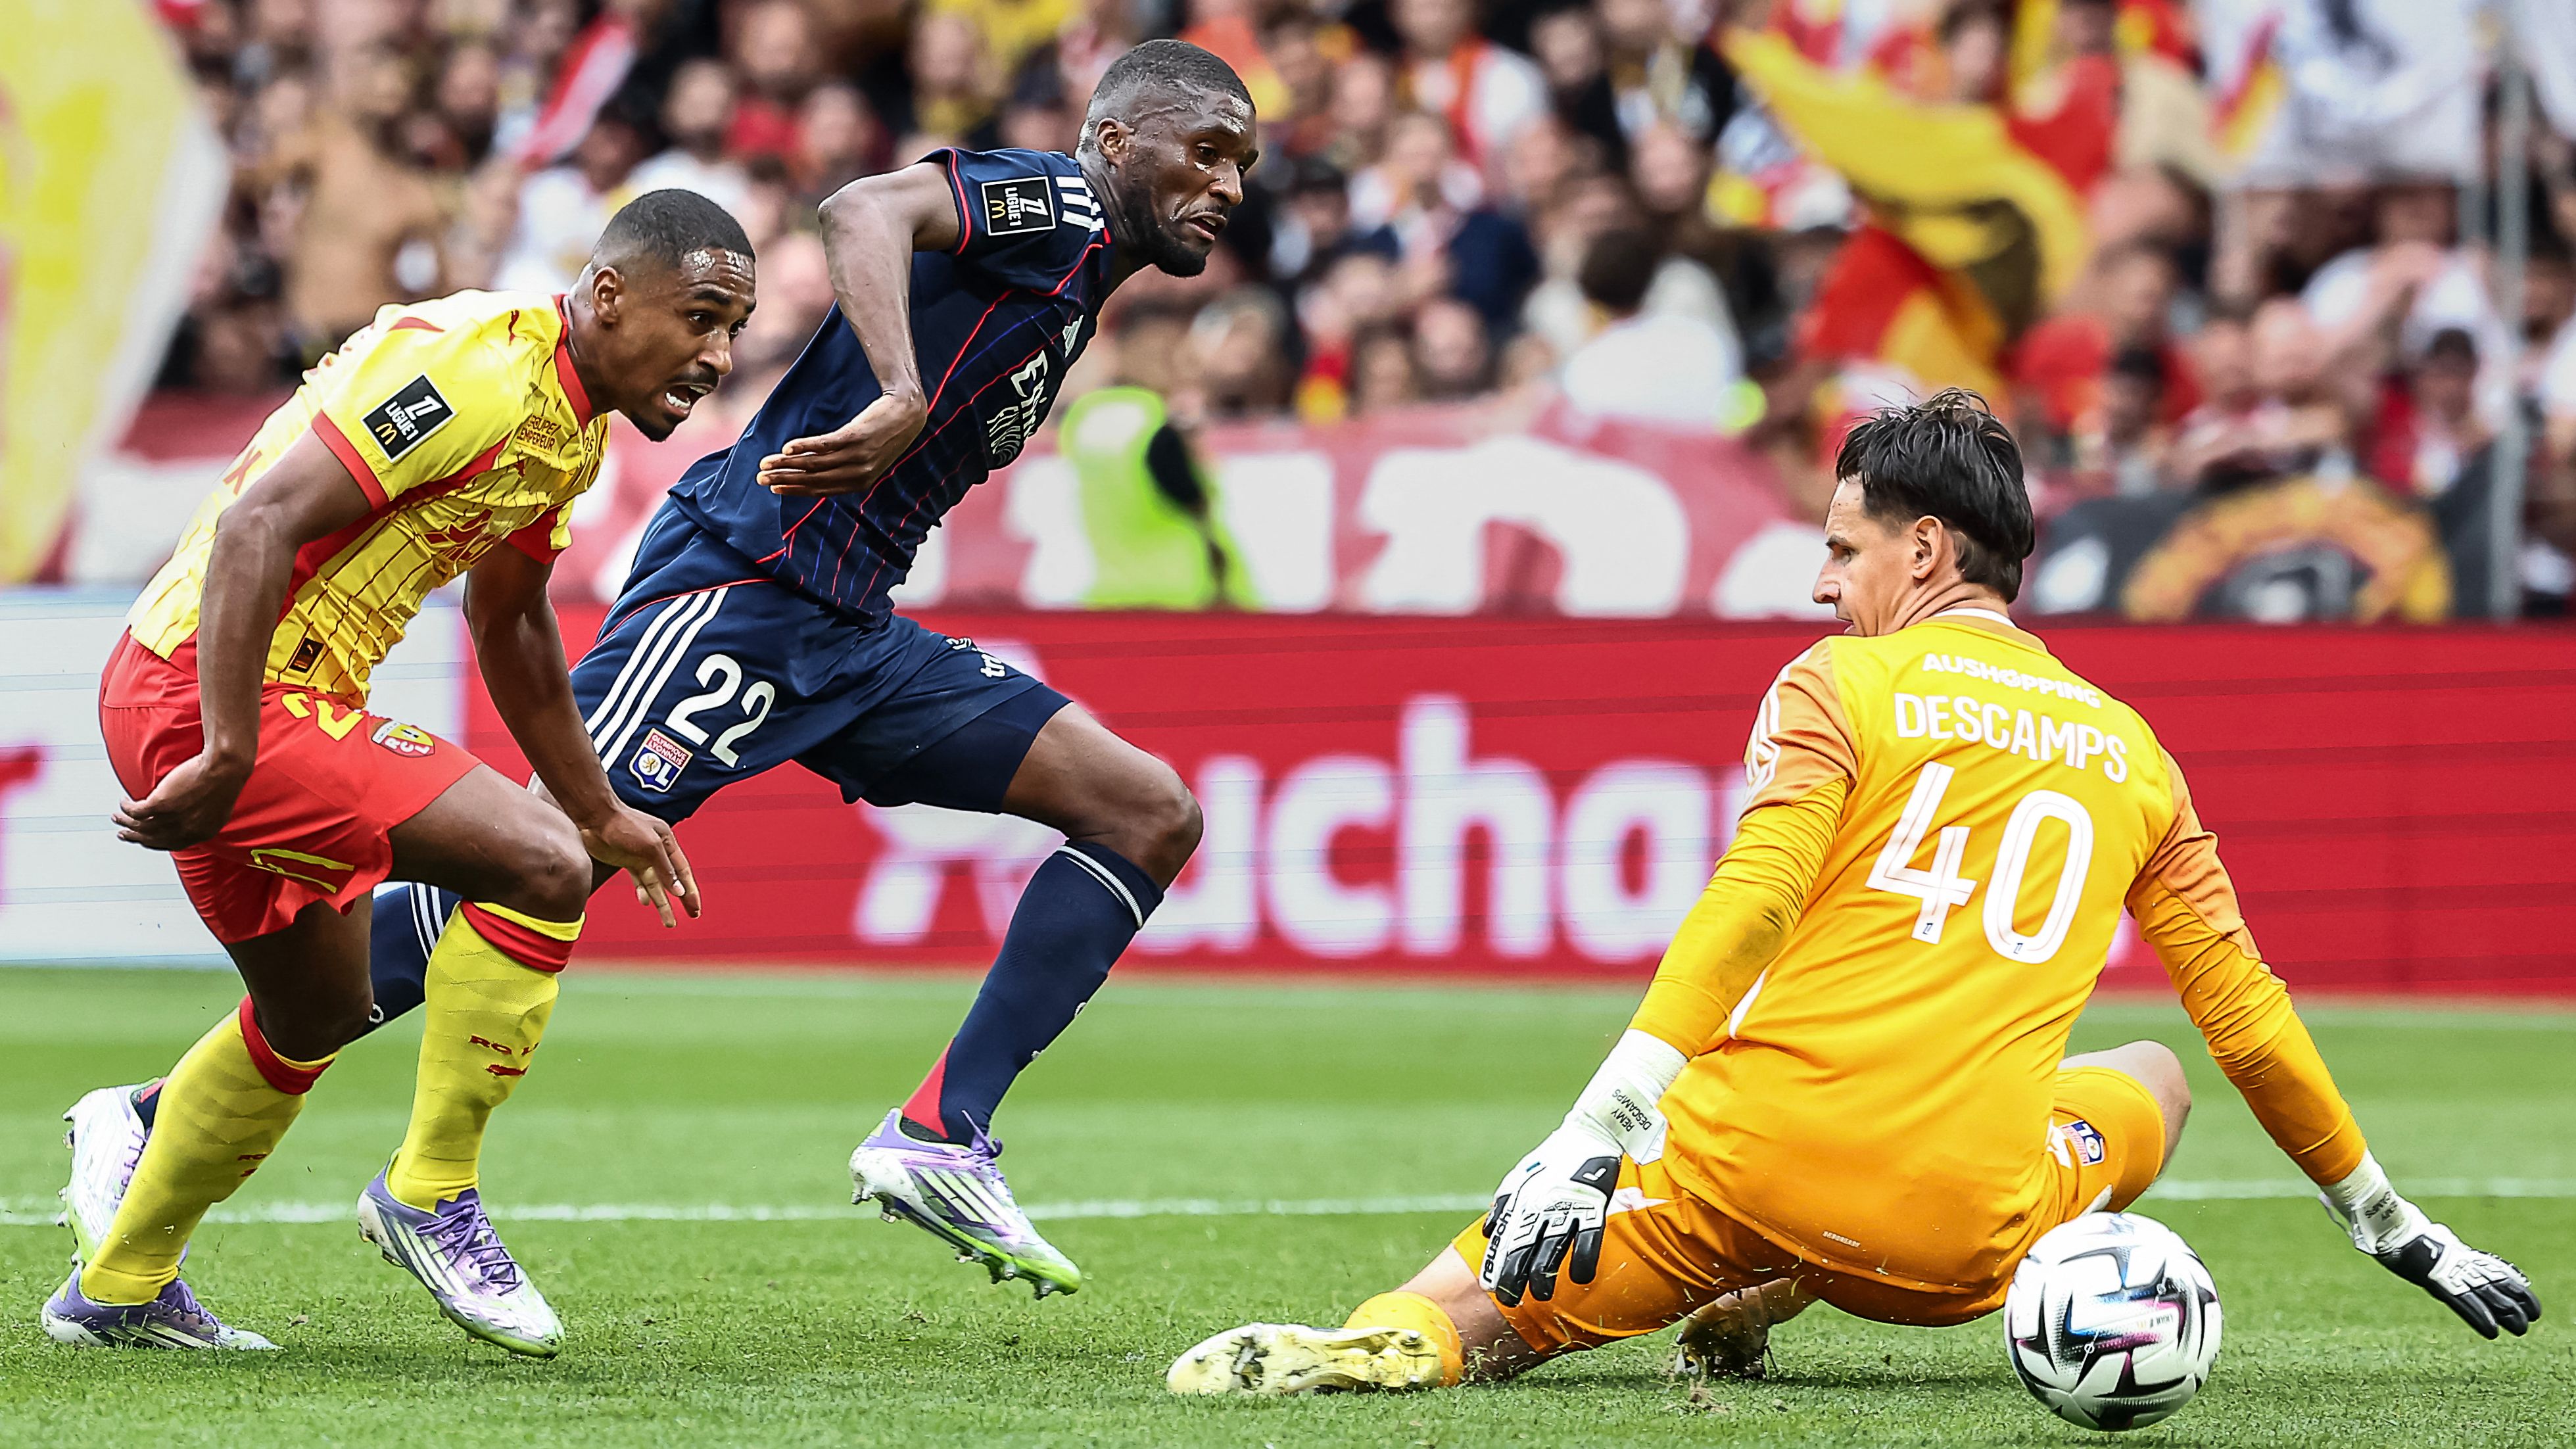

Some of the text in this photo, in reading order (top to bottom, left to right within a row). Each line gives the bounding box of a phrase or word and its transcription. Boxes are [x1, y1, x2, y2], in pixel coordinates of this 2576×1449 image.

[1922, 653, 2101, 708] AUSHOPPING
[665, 653, 775, 768] 22
[1894, 692, 2127, 784] DESCAMPS
[647, 740, 684, 767] LYONNAIS
[651, 734, 688, 761] OLYMPIQUE
[1865, 761, 2094, 964] 40
[1610, 1108, 1634, 1132] REMY
[1611, 1089, 1652, 1131] DESCAMPS
[1483, 1210, 1512, 1283] reusch
